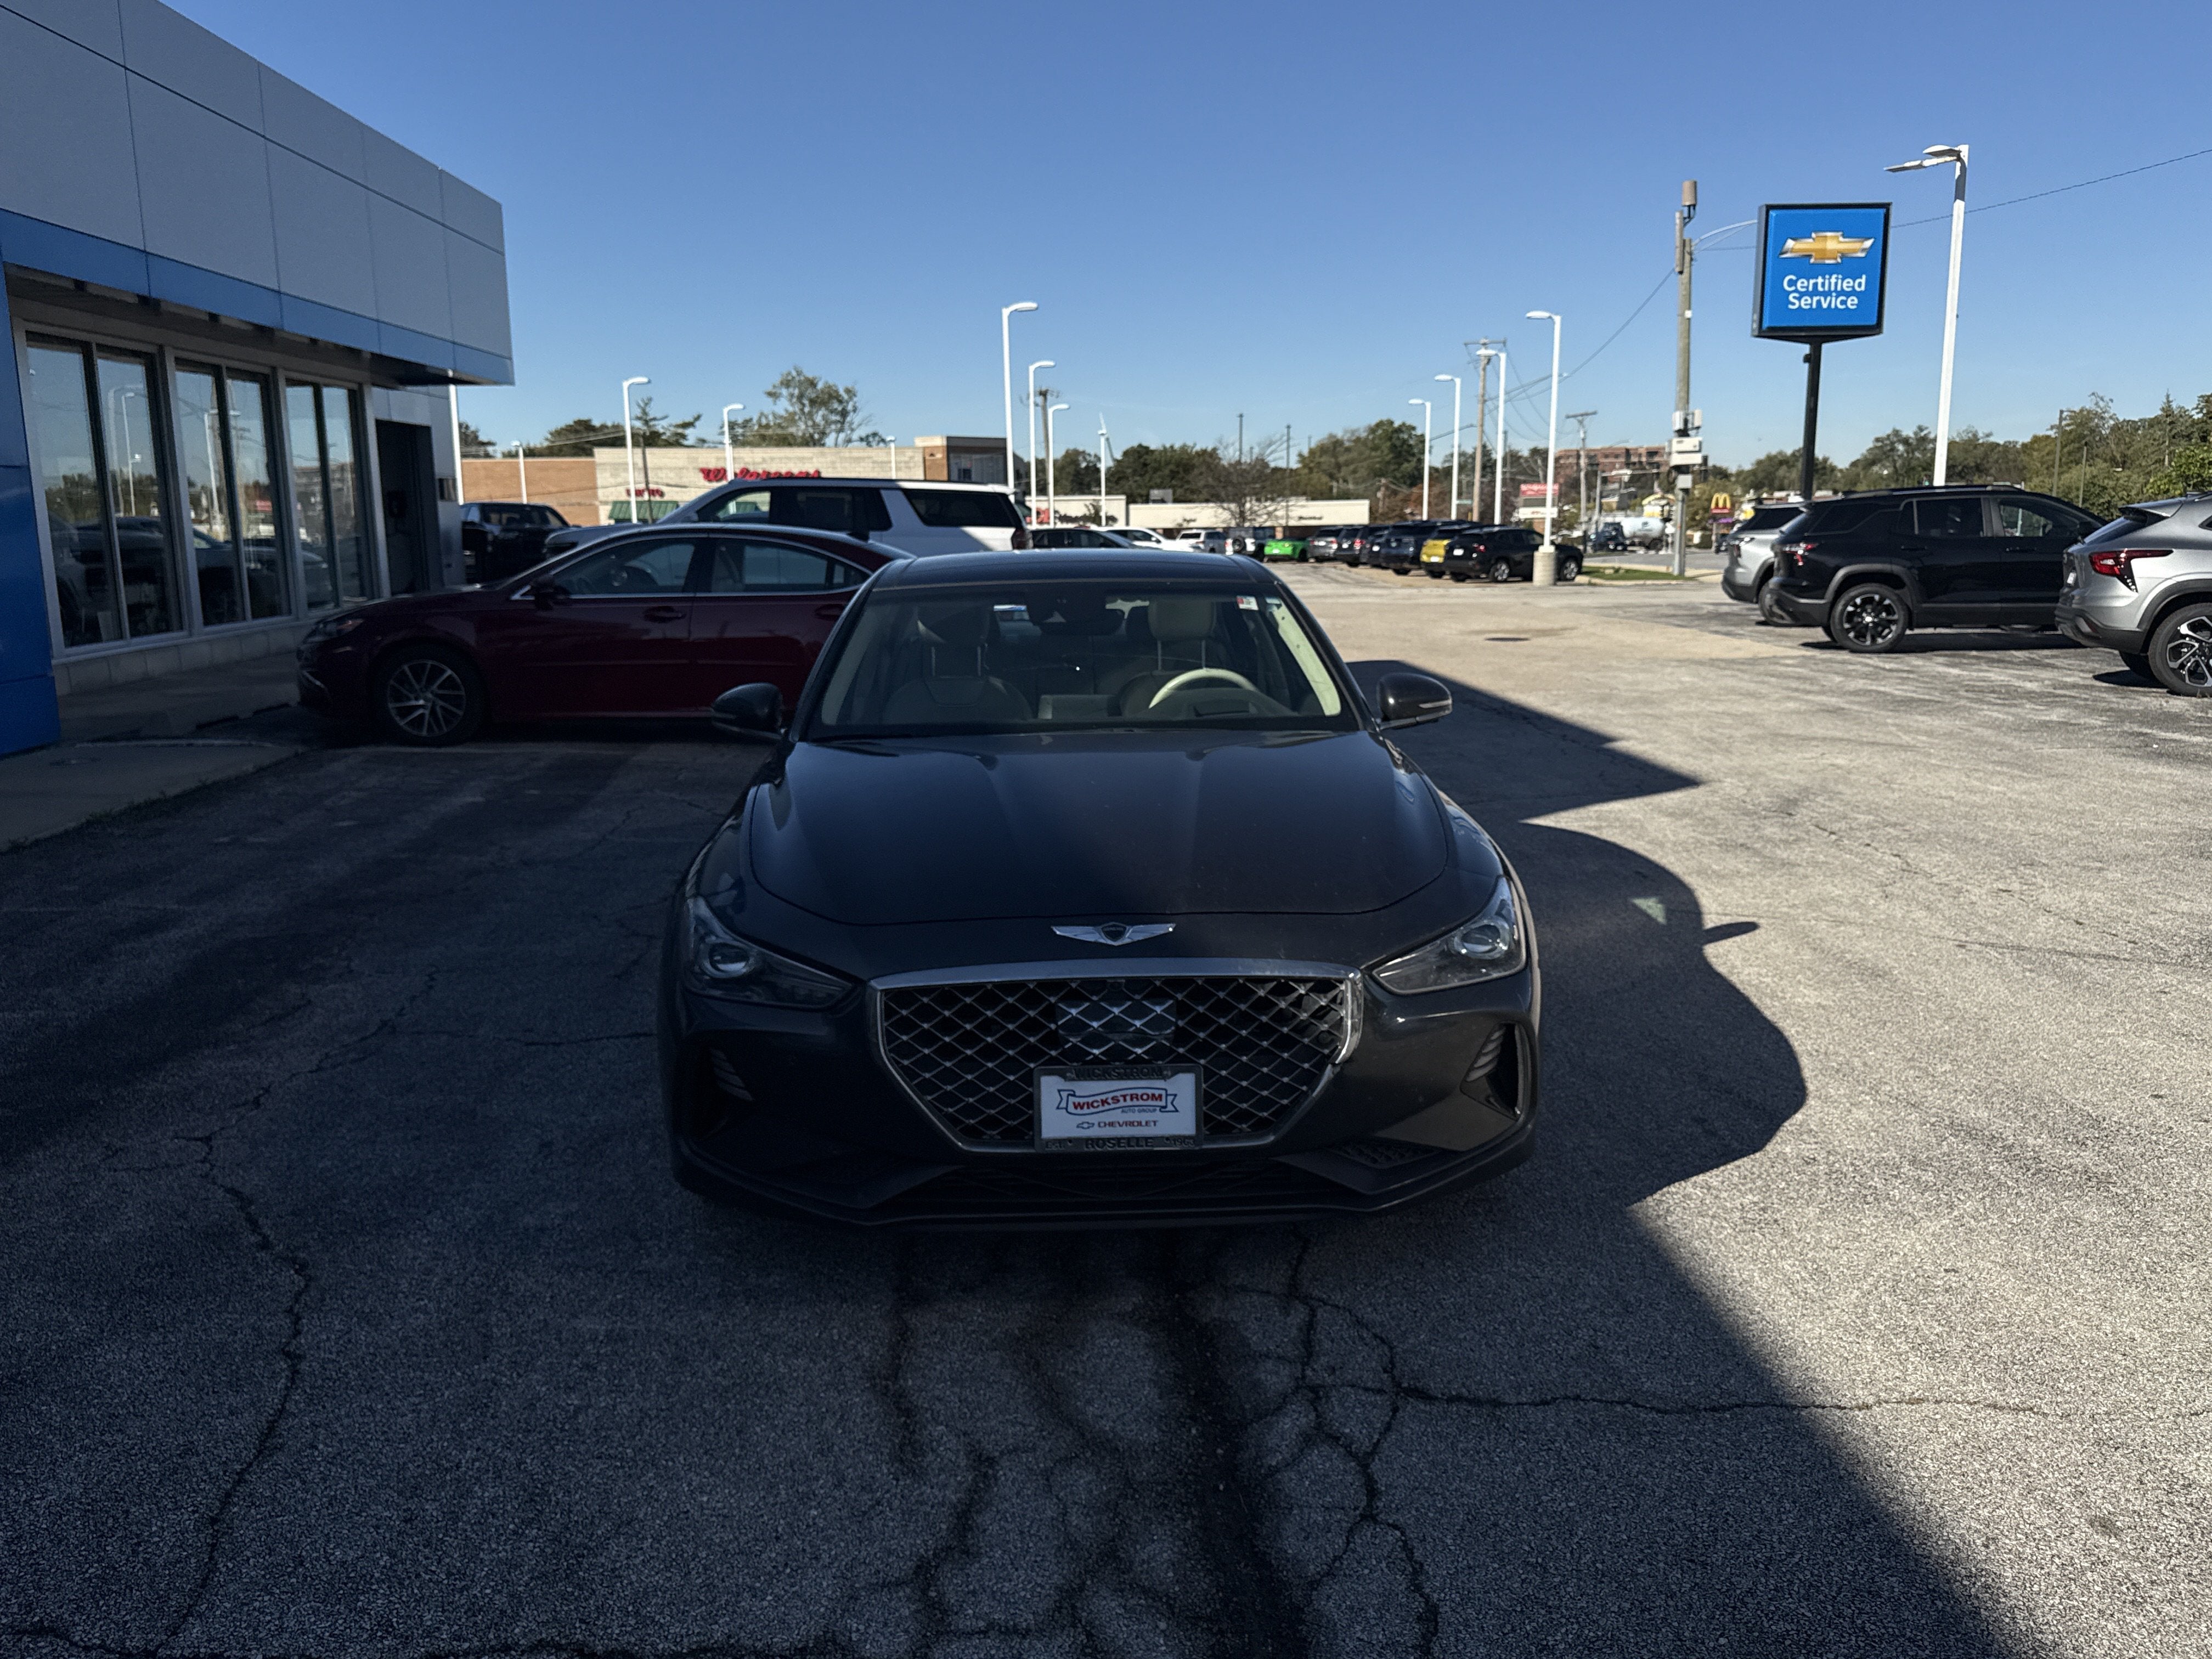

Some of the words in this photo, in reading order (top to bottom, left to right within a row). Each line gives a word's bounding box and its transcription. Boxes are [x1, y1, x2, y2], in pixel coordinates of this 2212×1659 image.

[1783, 273, 1866, 292] Certified
[1787, 292, 1859, 309] Service
[1074, 1067, 1163, 1078] WICKSTROM
[1073, 1093, 1163, 1110] WICKSTROM
[1098, 1120, 1159, 1128] CHEVROLET
[1085, 1137, 1153, 1149] ROSELLE
